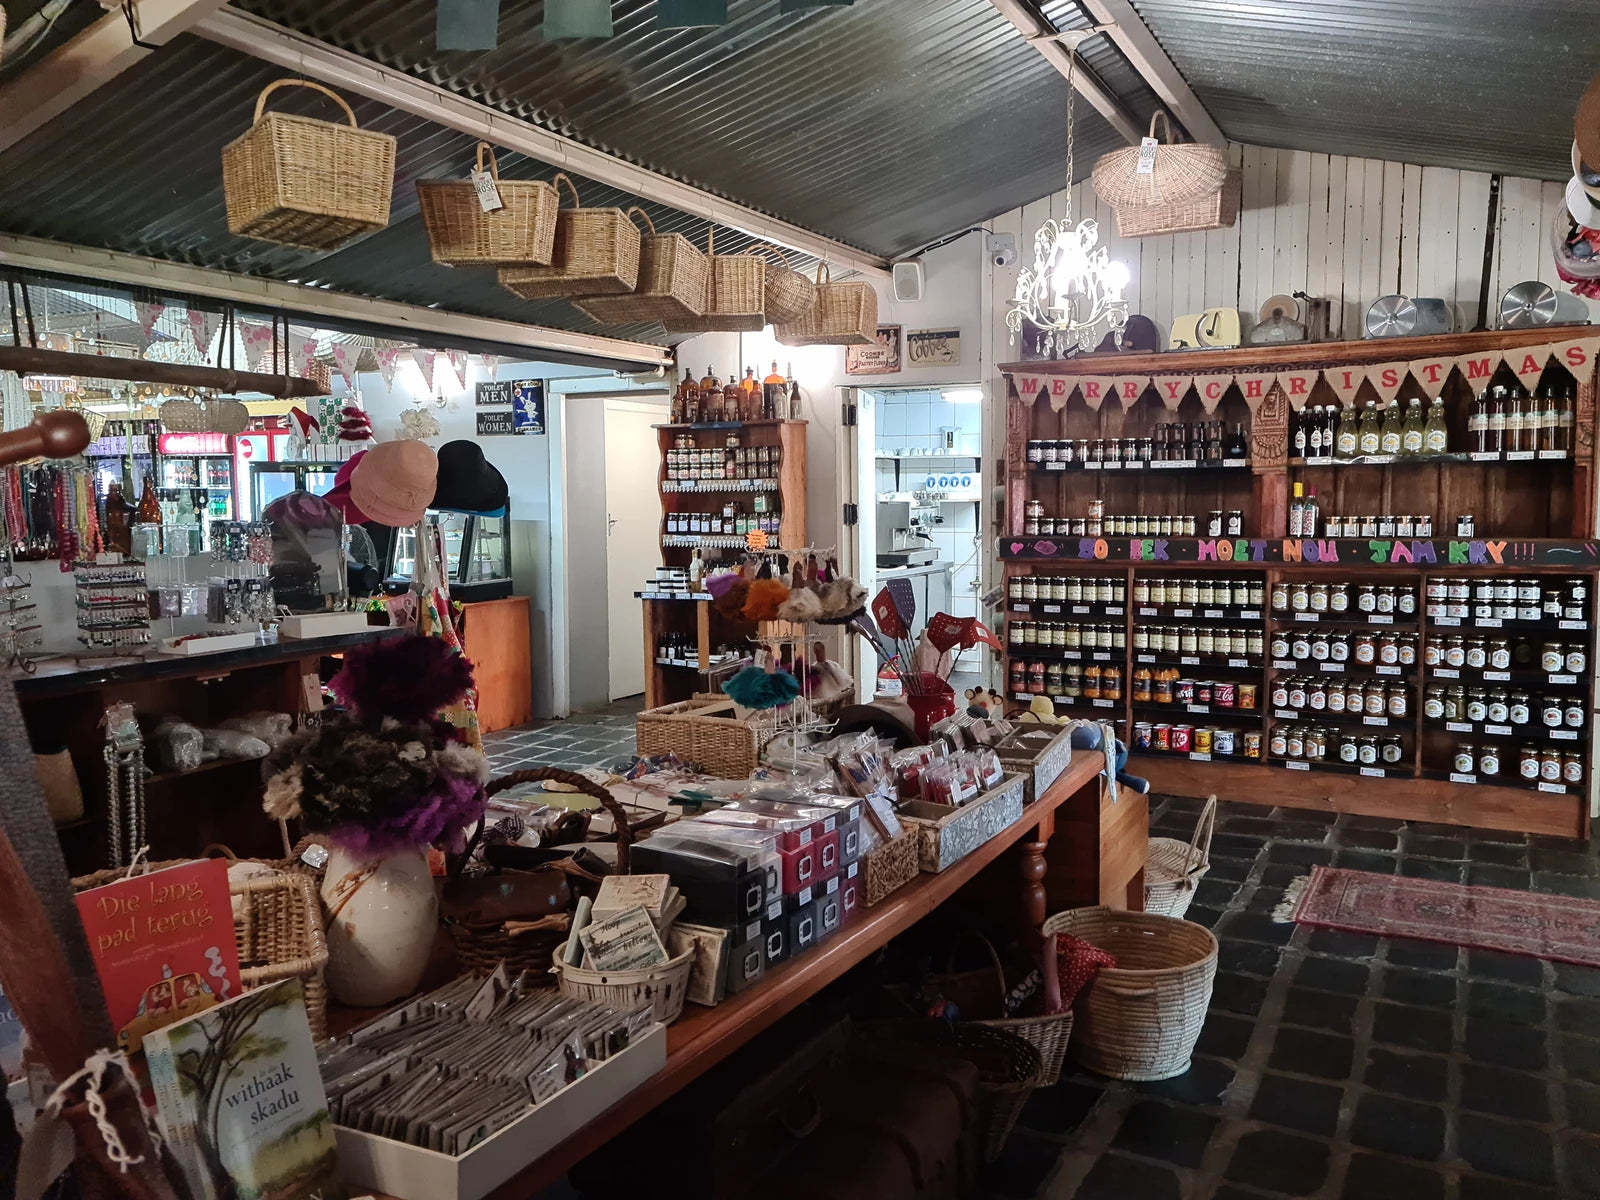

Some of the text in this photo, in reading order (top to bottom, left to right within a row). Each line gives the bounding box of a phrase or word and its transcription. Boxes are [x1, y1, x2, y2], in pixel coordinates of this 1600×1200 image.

[477, 183, 495, 194] ROSE
[1020, 346, 1587, 400] MERRY CHRISTMAS
[480, 391, 508, 402] MEN
[478, 422, 512, 432] WOMEN
[1078, 539, 1109, 560] SO
[1130, 539, 1169, 562] BEK
[1198, 539, 1267, 562] MOET
[1283, 539, 1339, 563] NOU
[1369, 540, 1437, 564] JAM
[97, 876, 203, 919] Die lang
[98, 917, 137, 958] pad
[147, 901, 215, 934] terug
[224, 1062, 295, 1109] withaak
[250, 1088, 300, 1126] skadu
